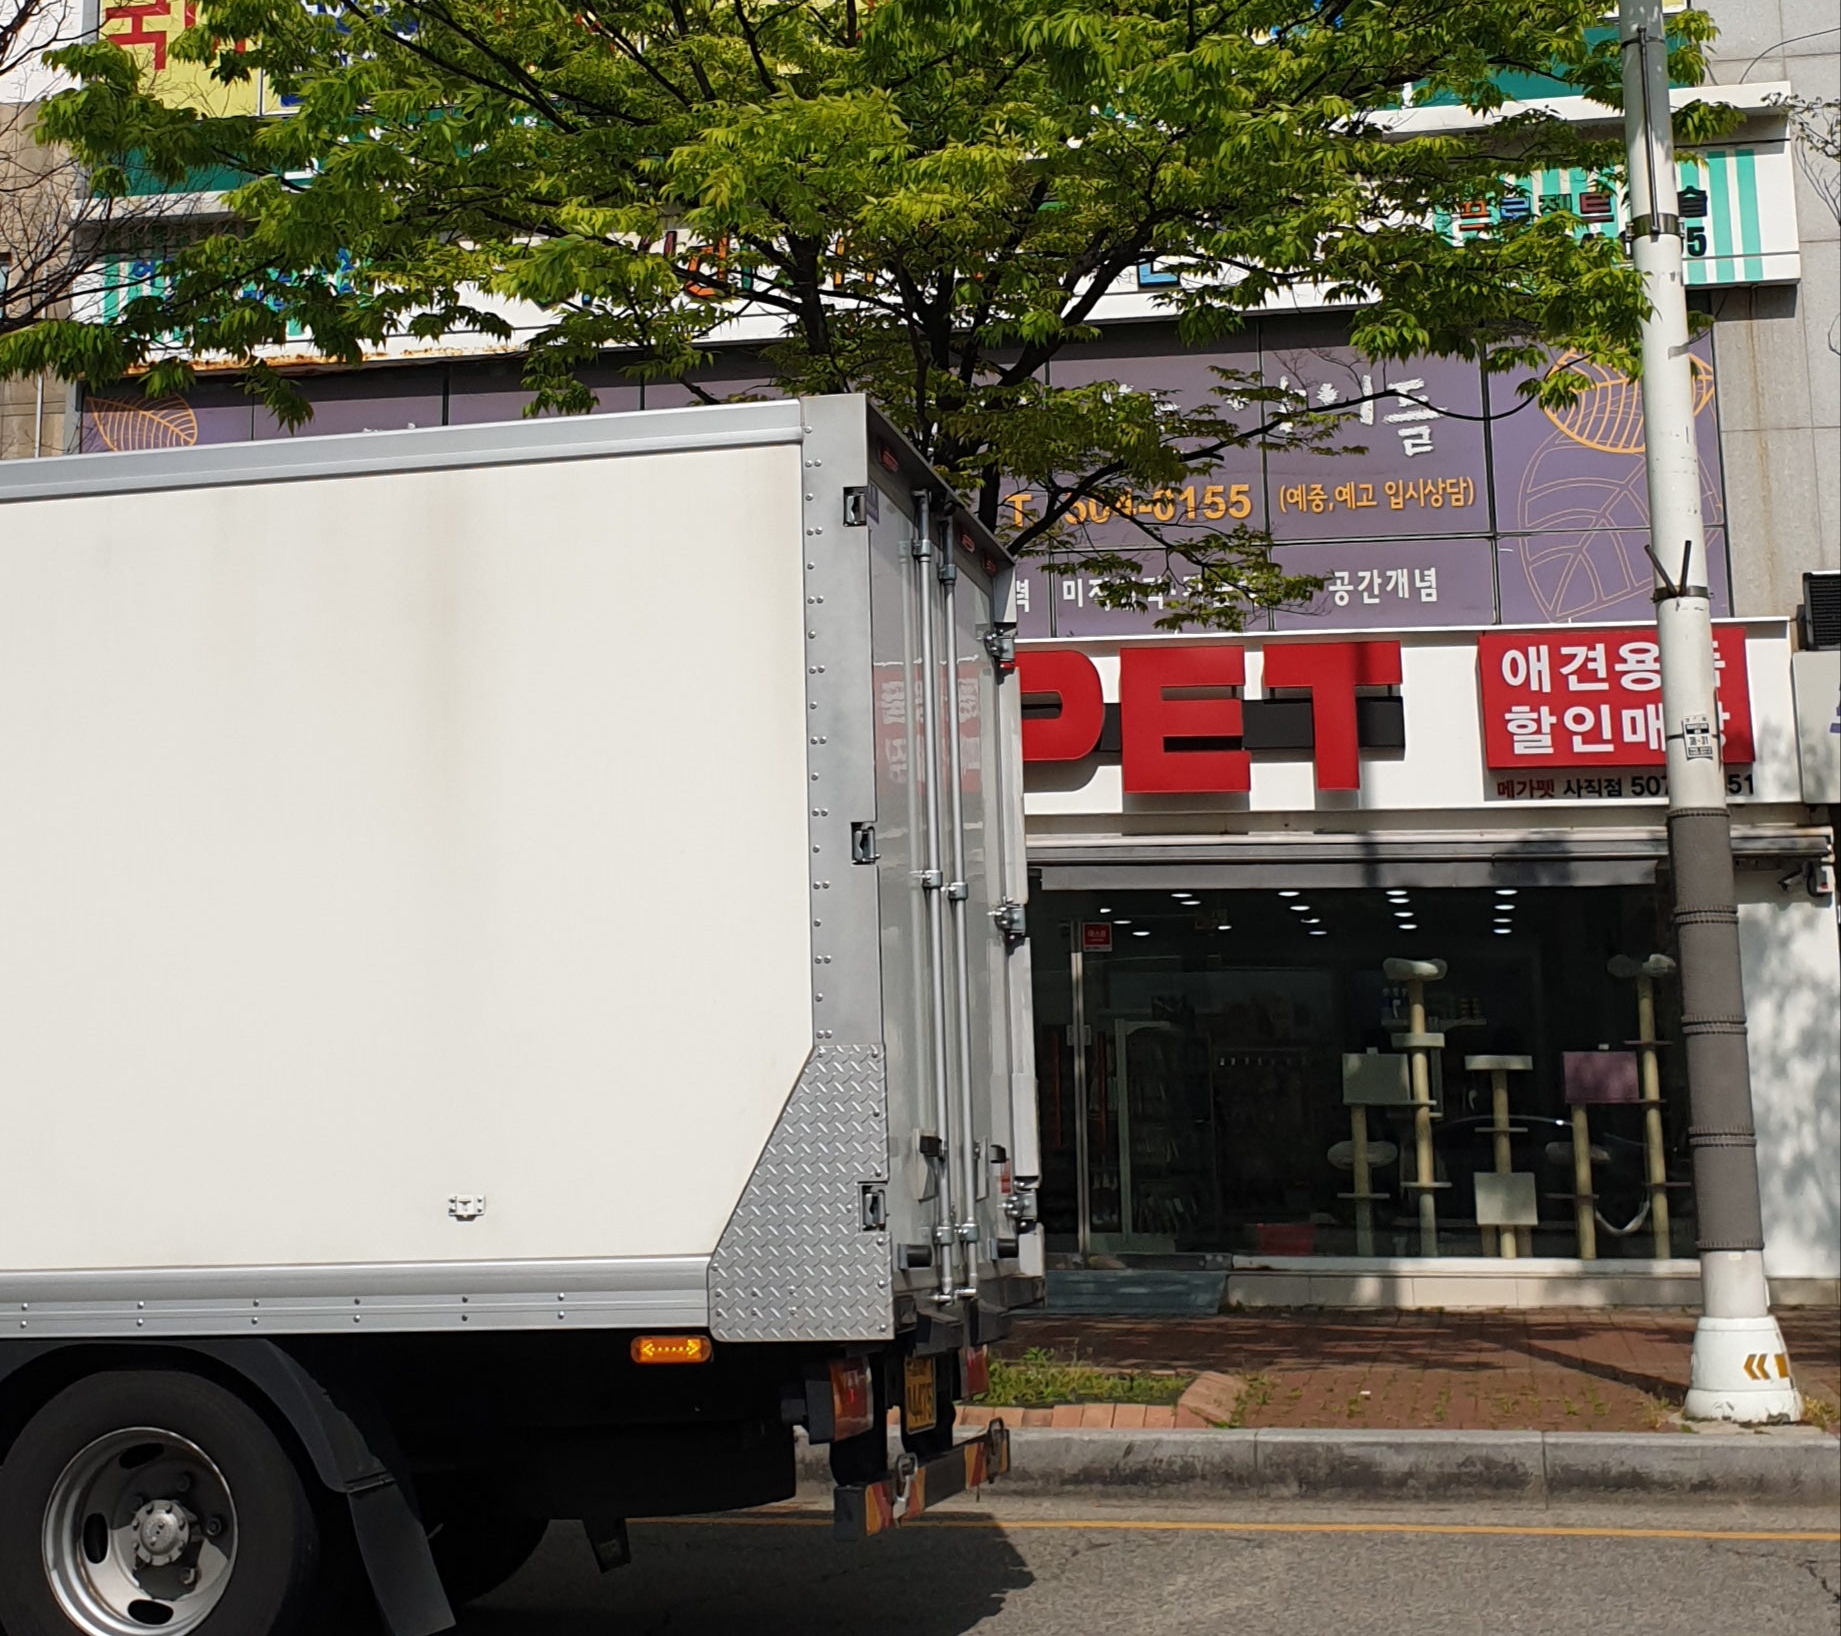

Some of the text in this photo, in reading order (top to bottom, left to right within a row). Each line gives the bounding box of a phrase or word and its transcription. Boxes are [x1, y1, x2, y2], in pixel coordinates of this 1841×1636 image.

[1279, 475, 1475, 513] (예중,예고 입시상담)
[1328, 566, 1438, 607] 공간개념
[1501, 639, 1726, 694] 애견용
[1015, 640, 1403, 792] PET
[1496, 778, 1556, 800] 메가펫
[1563, 777, 1623, 798] 사직점
